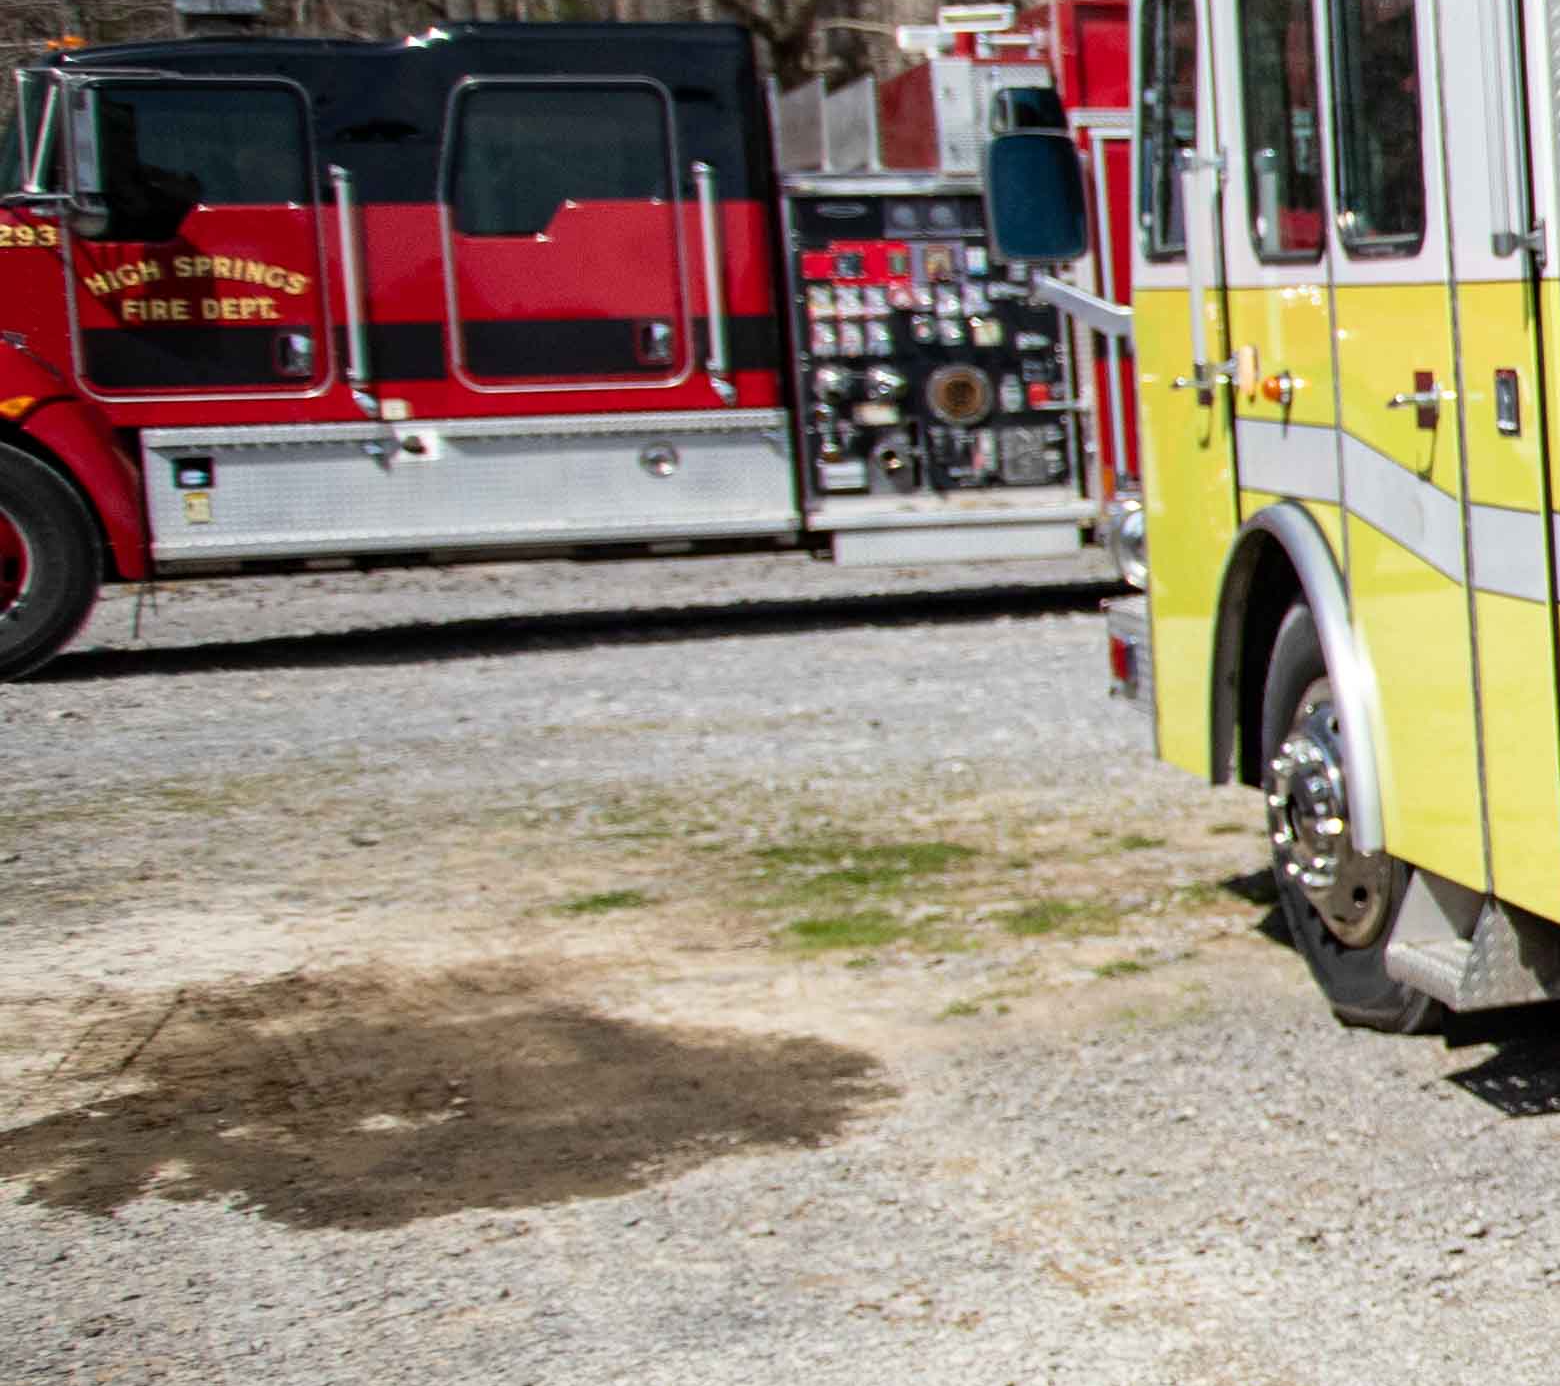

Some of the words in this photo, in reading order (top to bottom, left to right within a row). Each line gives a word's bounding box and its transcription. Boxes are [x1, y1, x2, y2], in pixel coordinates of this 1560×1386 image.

[83, 259, 161, 296] HIGH
[172, 255, 310, 295] SPRINGS
[121, 297, 191, 321] FIRE
[202, 297, 281, 320] DEPT.
